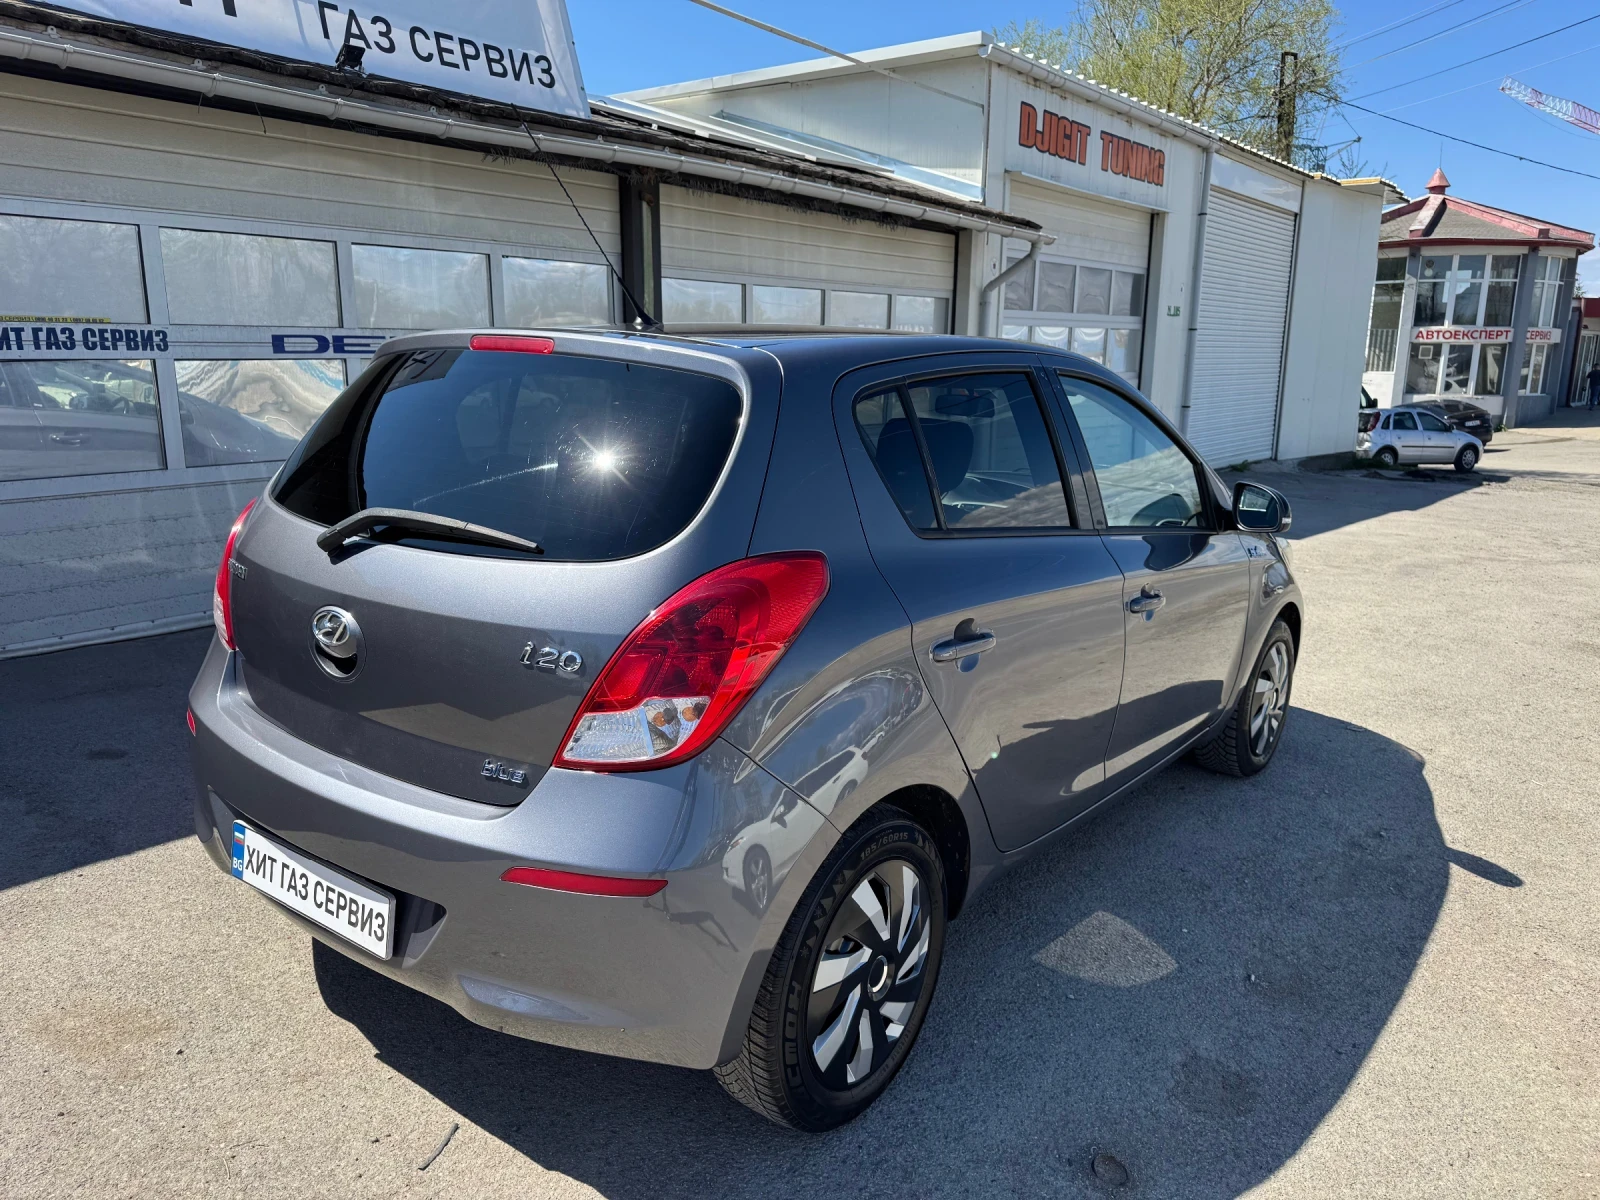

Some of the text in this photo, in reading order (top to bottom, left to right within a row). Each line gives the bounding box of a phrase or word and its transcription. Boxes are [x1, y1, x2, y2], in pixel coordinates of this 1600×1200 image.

[318, 0, 556, 89] ГАЗ СЕРВИЗ
[1018, 101, 1166, 187] DJIGIT TUNING
[31, 327, 77, 351] ГАЗ
[81, 327, 169, 352] СЕРВИЗ
[271, 334, 396, 354] DE
[1415, 329, 1512, 340] АВТОЕКСПЕРТ
[1525, 330, 1552, 341] СЕРВИЗ
[519, 640, 583, 673] i20
[232, 857, 243, 871] BG
[245, 844, 386, 942] ХИТ ГАЗ СЕРВИЗ
